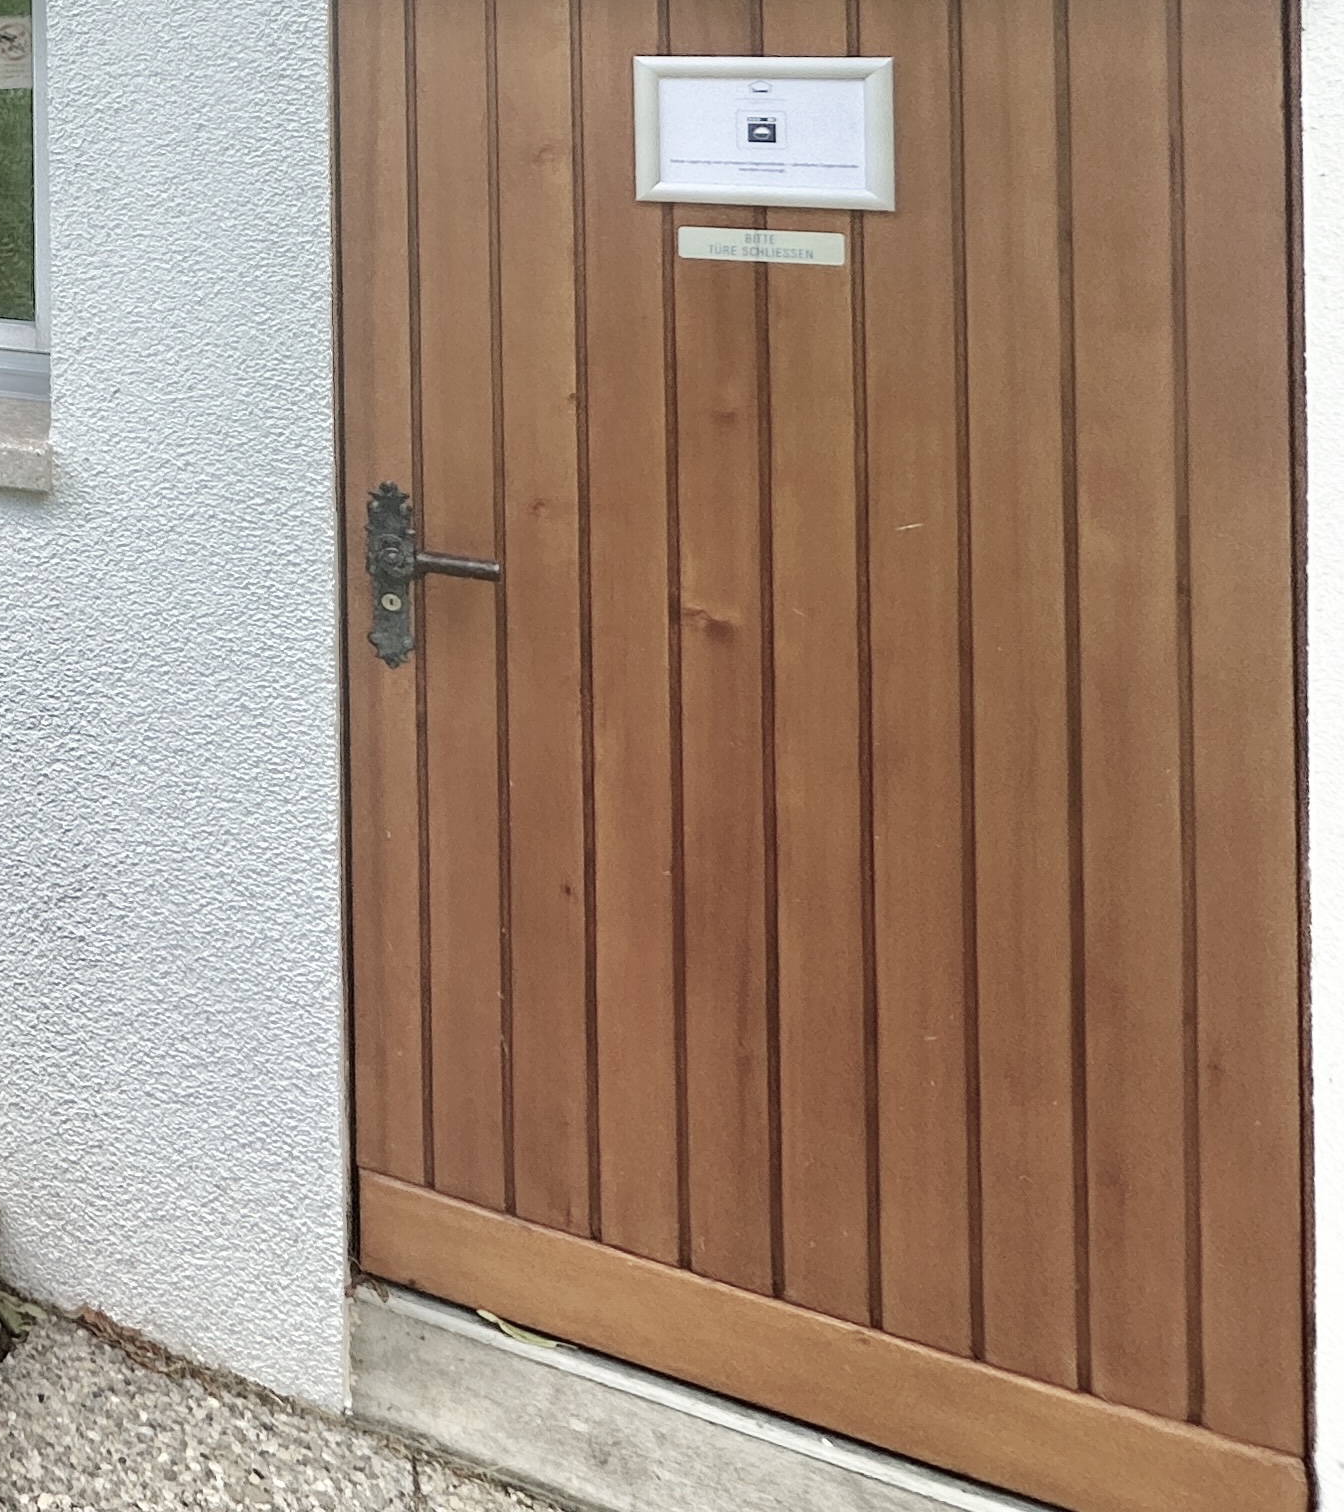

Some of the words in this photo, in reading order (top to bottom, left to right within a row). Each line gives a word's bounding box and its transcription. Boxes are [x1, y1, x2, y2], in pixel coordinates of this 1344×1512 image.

[744, 233, 775, 245] BITTE
[709, 243, 737, 256] TÜRE
[741, 246, 814, 259] SCHLIESSEN
